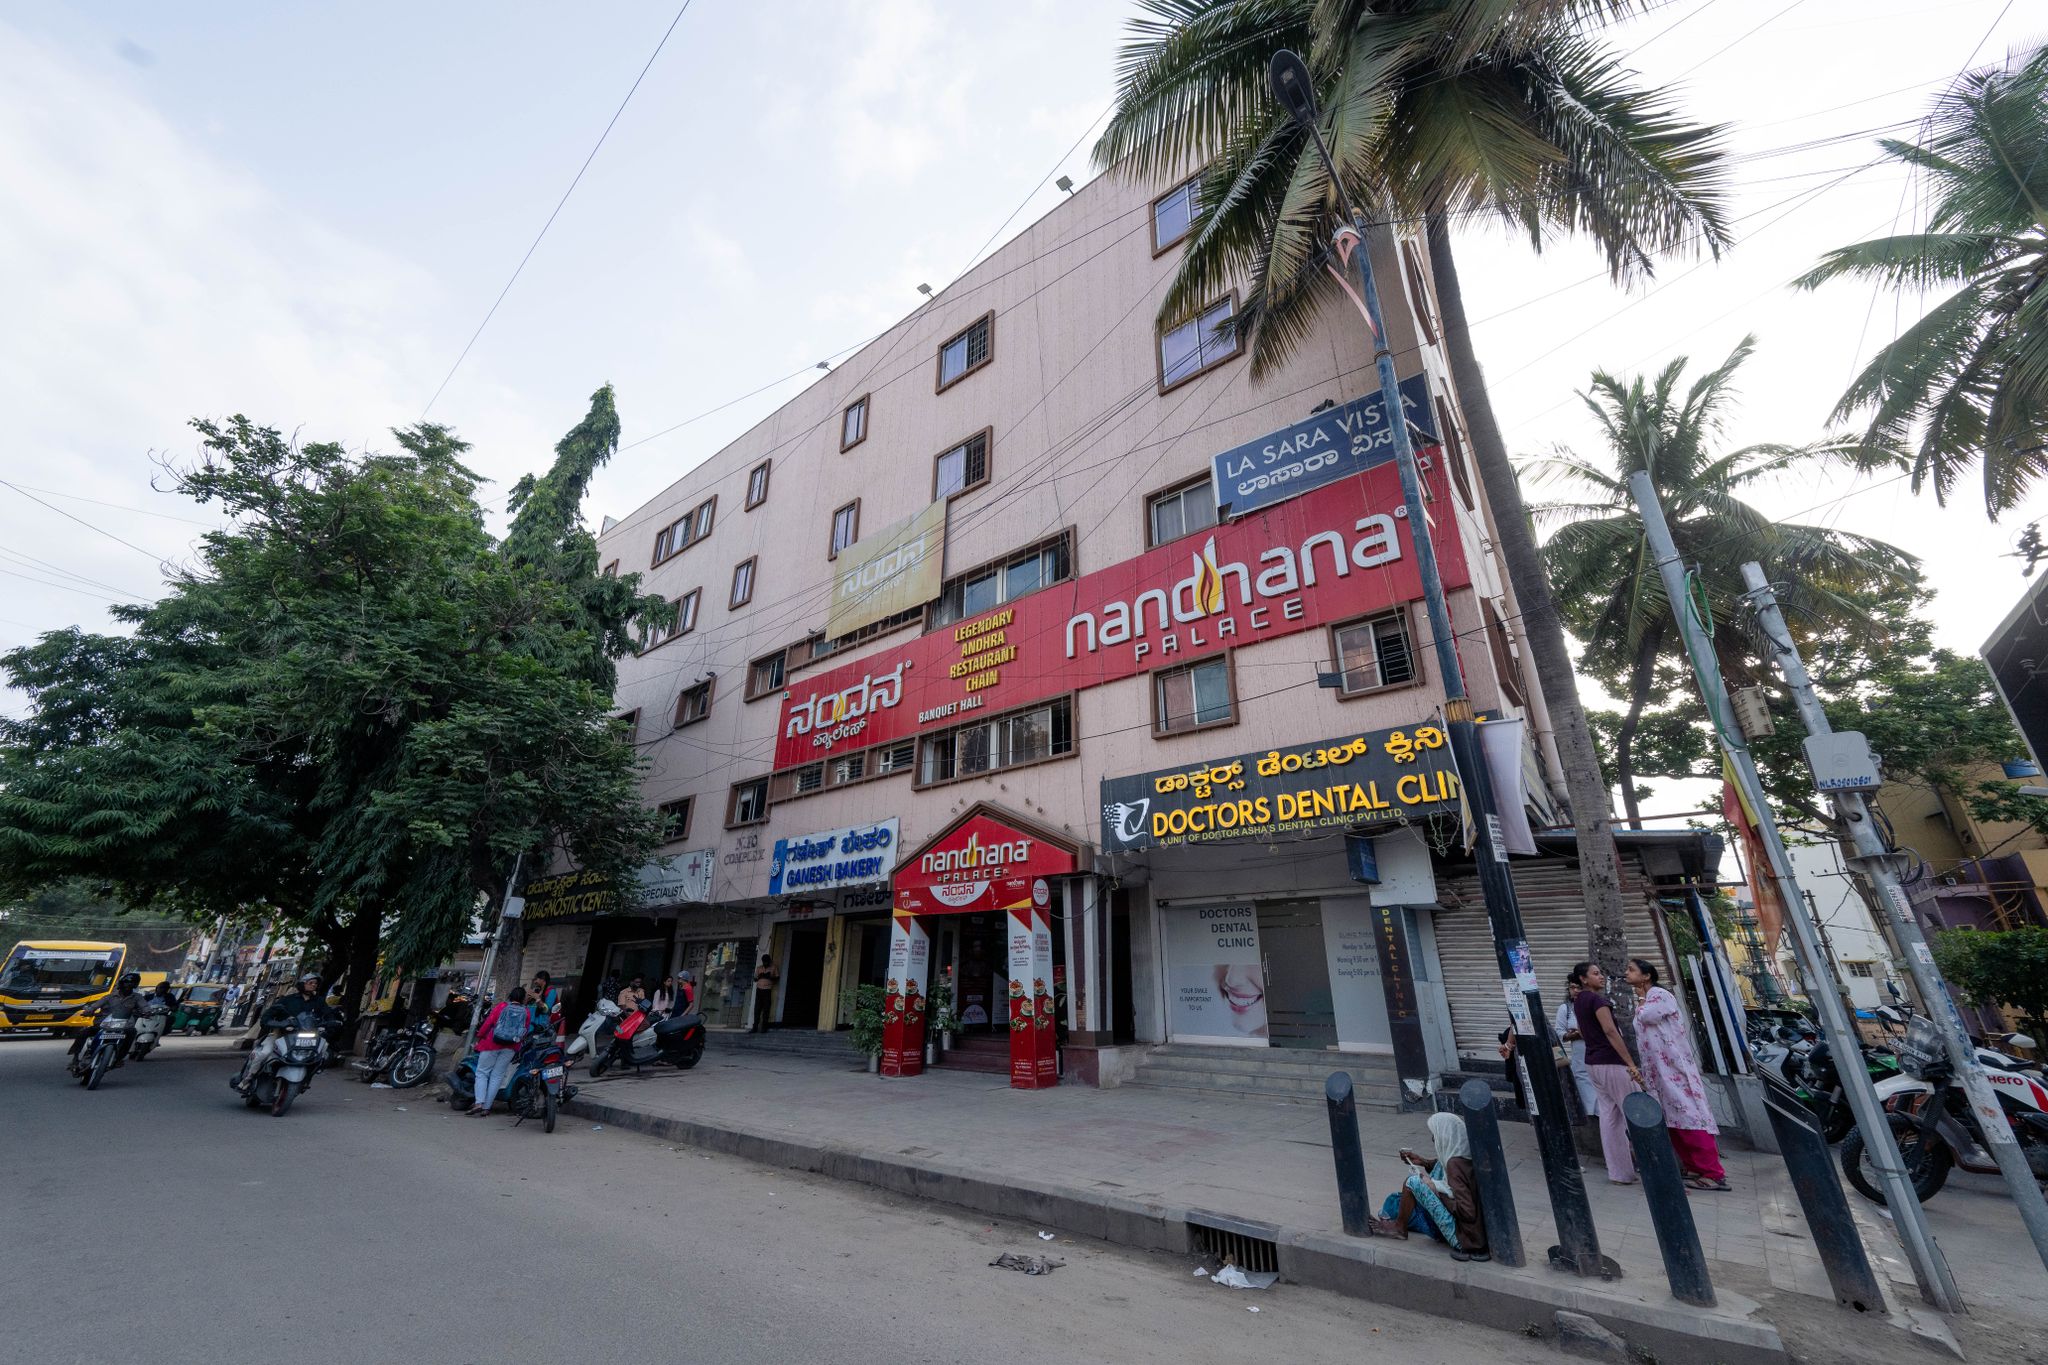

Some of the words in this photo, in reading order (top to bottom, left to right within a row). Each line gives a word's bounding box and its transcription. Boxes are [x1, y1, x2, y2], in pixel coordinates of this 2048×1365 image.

[1227, 454, 1256, 479] LA
[1262, 427, 1330, 465] SARA
[1336, 393, 1418, 435] VISA
[1066, 535, 1402, 659] nandhana
[954, 609, 1014, 642] LEGENDARY
[1134, 597, 1304, 663] PALACE
[961, 631, 1006, 658] ANDHRA
[950, 645, 1018, 679] RESTAURANT
[966, 670, 998, 693] CHAIN
[786, 662, 904, 738] ನಂದನ
[918, 701, 958, 724] BANQUET
[959, 695, 983, 712] HALL
[1152, 797, 1271, 838] DOCTORS
[1277, 780, 1390, 820] DENTAL
[1167, 834, 1186, 845] UNIT
[1188, 832, 1201, 843] OF
[1202, 827, 1240, 841] DOCTOR
[1241, 823, 1277, 837] ASHA'S
[1278, 818, 1318, 832] DENTAL
[1319, 814, 1355, 828] CLINIC
[1356, 811, 1378, 824] PVT
[1381, 808, 1406, 820] LTD.
[921, 831, 1030, 874] nandhana
[787, 863, 834, 888] GANESH
[834, 855, 883, 880] BAKERY
[942, 867, 1002, 884] PALACE
[527, 894, 582, 921] DIAGNOSTIC
[640, 885, 684, 900] SPECIALIST
[1200, 907, 1252, 919] DOCTORS
[1211, 922, 1254, 933] DENTAL
[1217, 938, 1255, 948] CLINIC
[1381, 908, 1398, 960] DENTAL
